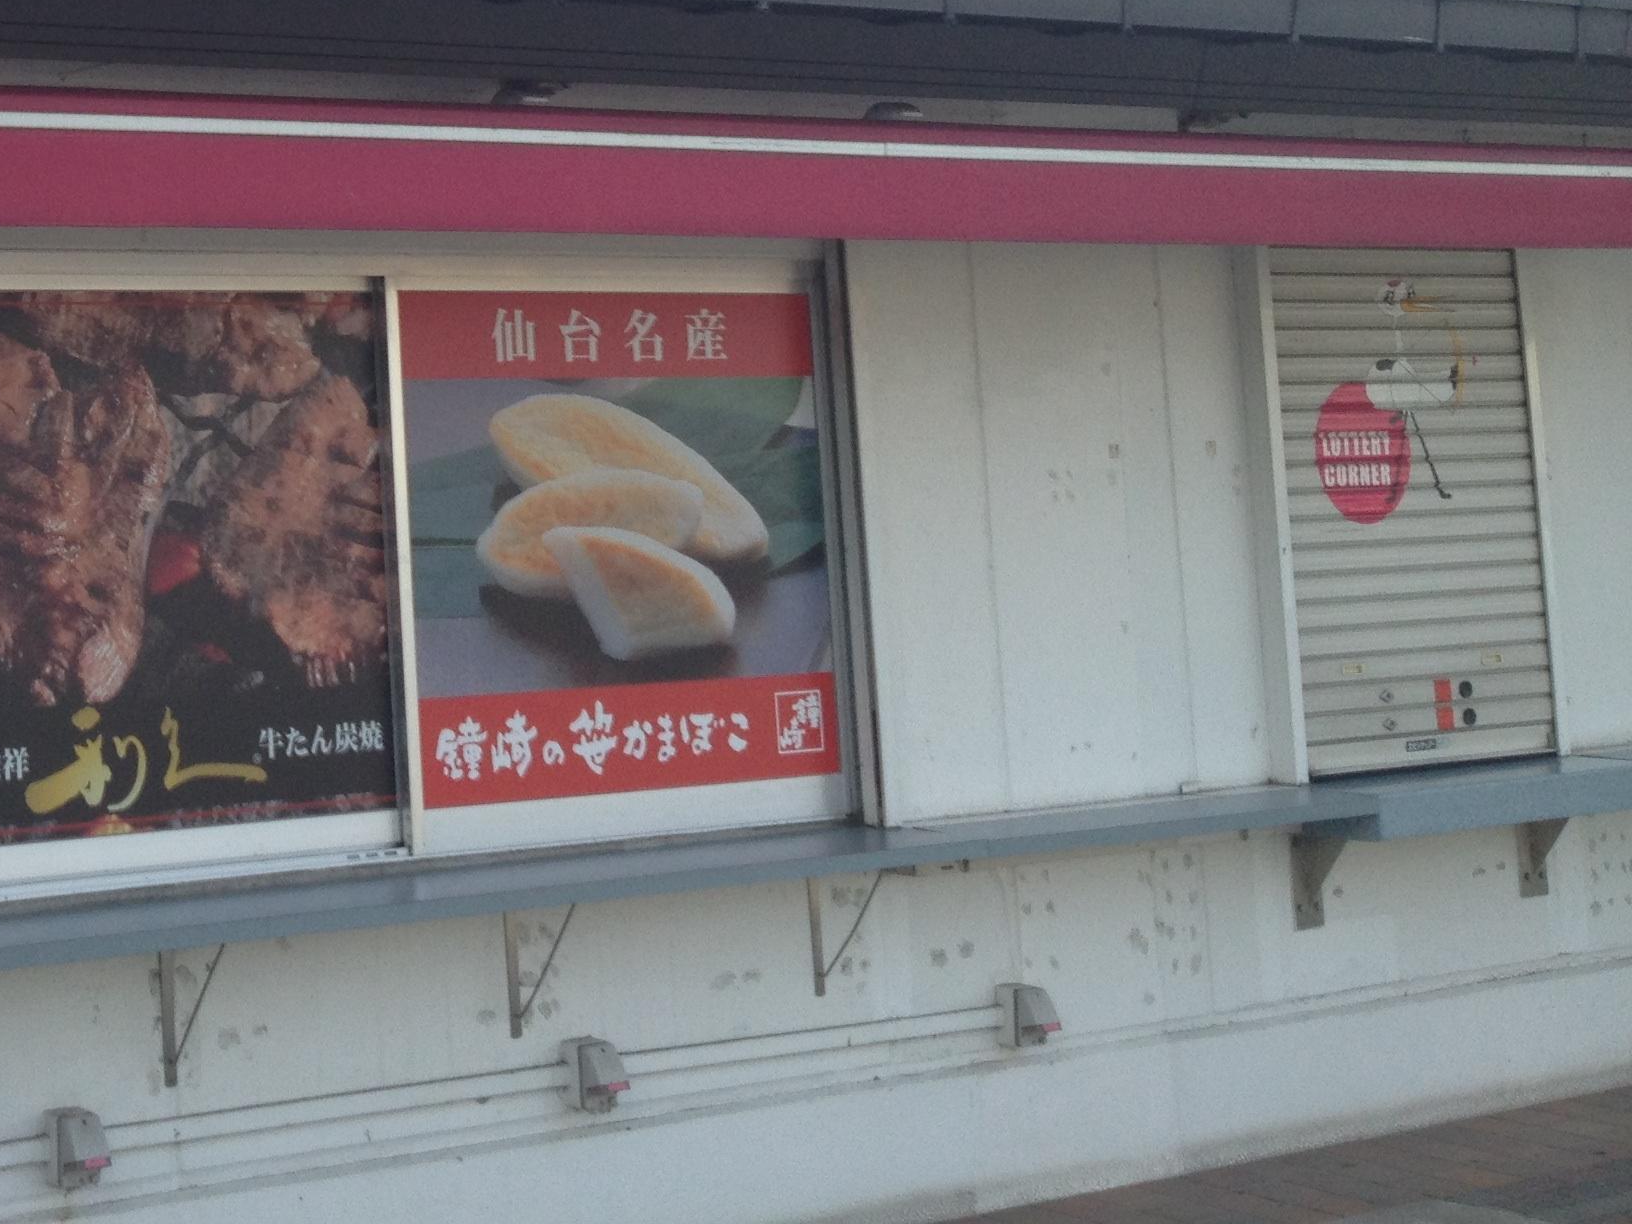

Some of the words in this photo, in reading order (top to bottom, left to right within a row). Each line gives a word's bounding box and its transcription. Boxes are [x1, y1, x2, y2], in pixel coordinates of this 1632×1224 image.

[491, 308, 728, 363] 仙台名産
[1319, 431, 1391, 457] LOTTERY
[1323, 463, 1392, 488] CORNER
[259, 721, 385, 756] 牛たん炭焼
[435, 700, 751, 779] 鐘崎の笹かまぼこ
